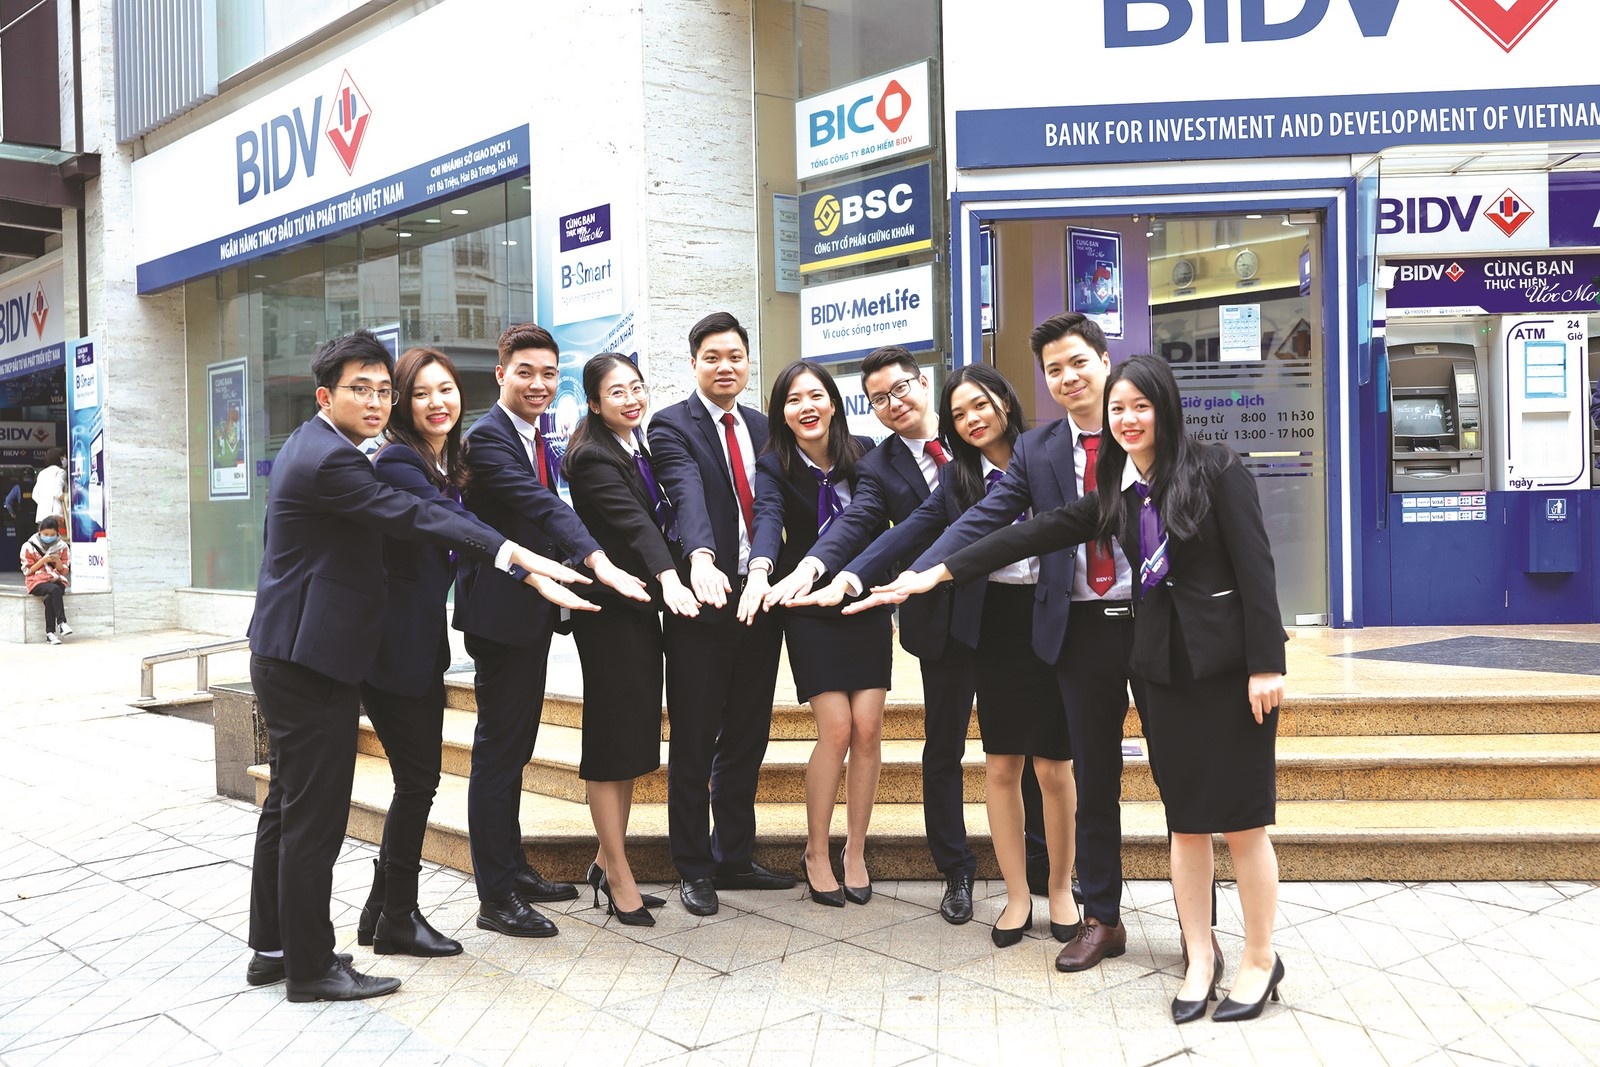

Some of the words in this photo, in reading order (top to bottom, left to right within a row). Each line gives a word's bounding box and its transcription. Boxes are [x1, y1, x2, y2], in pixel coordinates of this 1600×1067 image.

[1045, 121, 1100, 147] BANK
[1106, 120, 1143, 145] FOR
[1149, 114, 1276, 143] INVESTMENT
[1280, 113, 1324, 138] AND
[1330, 106, 1478, 136] DEVELOPMENT
[1483, 105, 1508, 130] OF
[236, 95, 322, 205] BIDV
[851, 149, 860, 158] TY
[896, 135, 913, 146] BIDV
[430, 163, 442, 178] CHI
[442, 157, 464, 174] NHÁNH
[474, 147, 490, 162] GIAO
[506, 140, 511, 150] 1
[426, 183, 436, 195] 191
[436, 179, 444, 192] Bà
[460, 171, 470, 184] Hai
[470, 167, 478, 180] Bà
[498, 157, 506, 170] Hà
[506, 153, 518, 168] Nội
[842, 183, 913, 225] BSC
[220, 238, 238, 260] NGÂN
[239, 233, 258, 254] HÀNG
[258, 226, 278, 248] TMCP
[294, 214, 304, 236] TƯ
[305, 210, 316, 232] VÀ
[316, 203, 336, 228] PHÁT
[362, 188, 382, 214] VIỆT
[383, 181, 404, 206] NAM
[1376, 194, 1482, 234] BIDV
[566, 216, 582, 230] CÙNG
[814, 242, 830, 255] CÔNG
[831, 240, 840, 252] TY
[891, 222, 914, 240] KHOÁN
[561, 258, 612, 289] B-Smart
[1400, 264, 1445, 282] BIDV
[1484, 260, 1533, 277] CÙNG
[1536, 260, 1574, 277] BẠN
[1484, 278, 1516, 291] THỰC
[1520, 276, 1547, 290] HIỆN
[852, 323, 871, 336] sống
[1567, 320, 1580, 328] 24
[1514, 328, 1545, 340] ATM
[1180, 396, 1201, 408] Giờ
[1204, 396, 1233, 410] giao
[1236, 394, 1264, 409] dịch
[1183, 413, 1208, 426] áng
[1211, 414, 1225, 424] từ
[1241, 412, 1266, 422] 8:00
[1278, 412, 1288, 422] 11
[1292, 410, 1314, 421] h30
[1190, 429, 1212, 440] iều
[1215, 430, 1228, 440] từ
[1234, 429, 1266, 440] 13:00
[1278, 428, 1288, 438] 17
[1292, 428, 1314, 438] h00
[1508, 466, 1514, 474] 7
[1509, 477, 1533, 489] ngày
